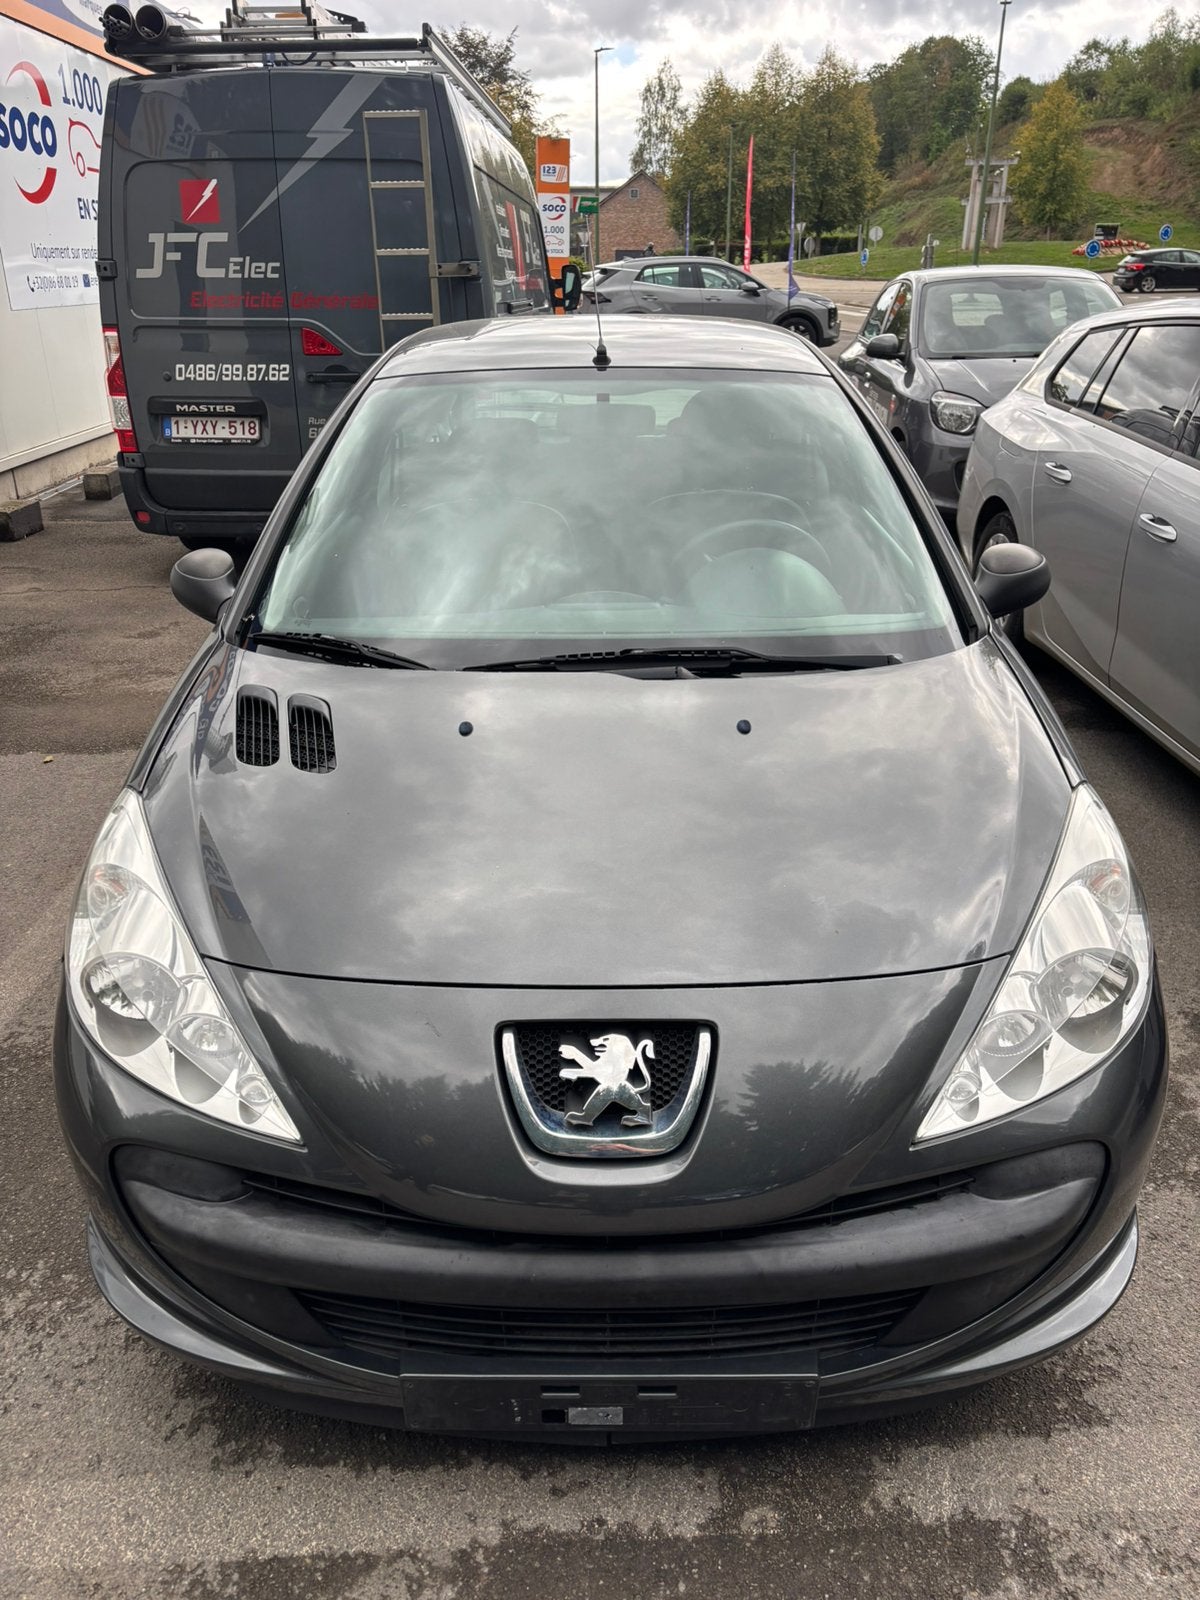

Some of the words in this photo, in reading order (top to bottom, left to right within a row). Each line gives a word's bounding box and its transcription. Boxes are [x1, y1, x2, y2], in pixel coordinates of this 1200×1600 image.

[58, 63, 103, 116] 1.000
[542, 165, 557, 174] 123
[77, 197, 91, 220] EN
[91, 199, 99, 220] S
[544, 225, 565, 234] 1.000
[30, 243, 71, 263] Uniquement
[71, 247, 81, 259] sur
[135, 231, 229, 279] JFC
[228, 255, 281, 279] Elec
[190, 290, 285, 309] Electricité
[175, 363, 290, 383] 0486/99.87.62
[175, 404, 236, 413] MASTER
[308, 416, 326, 425] Rue
[165, 428, 171, 436] B
